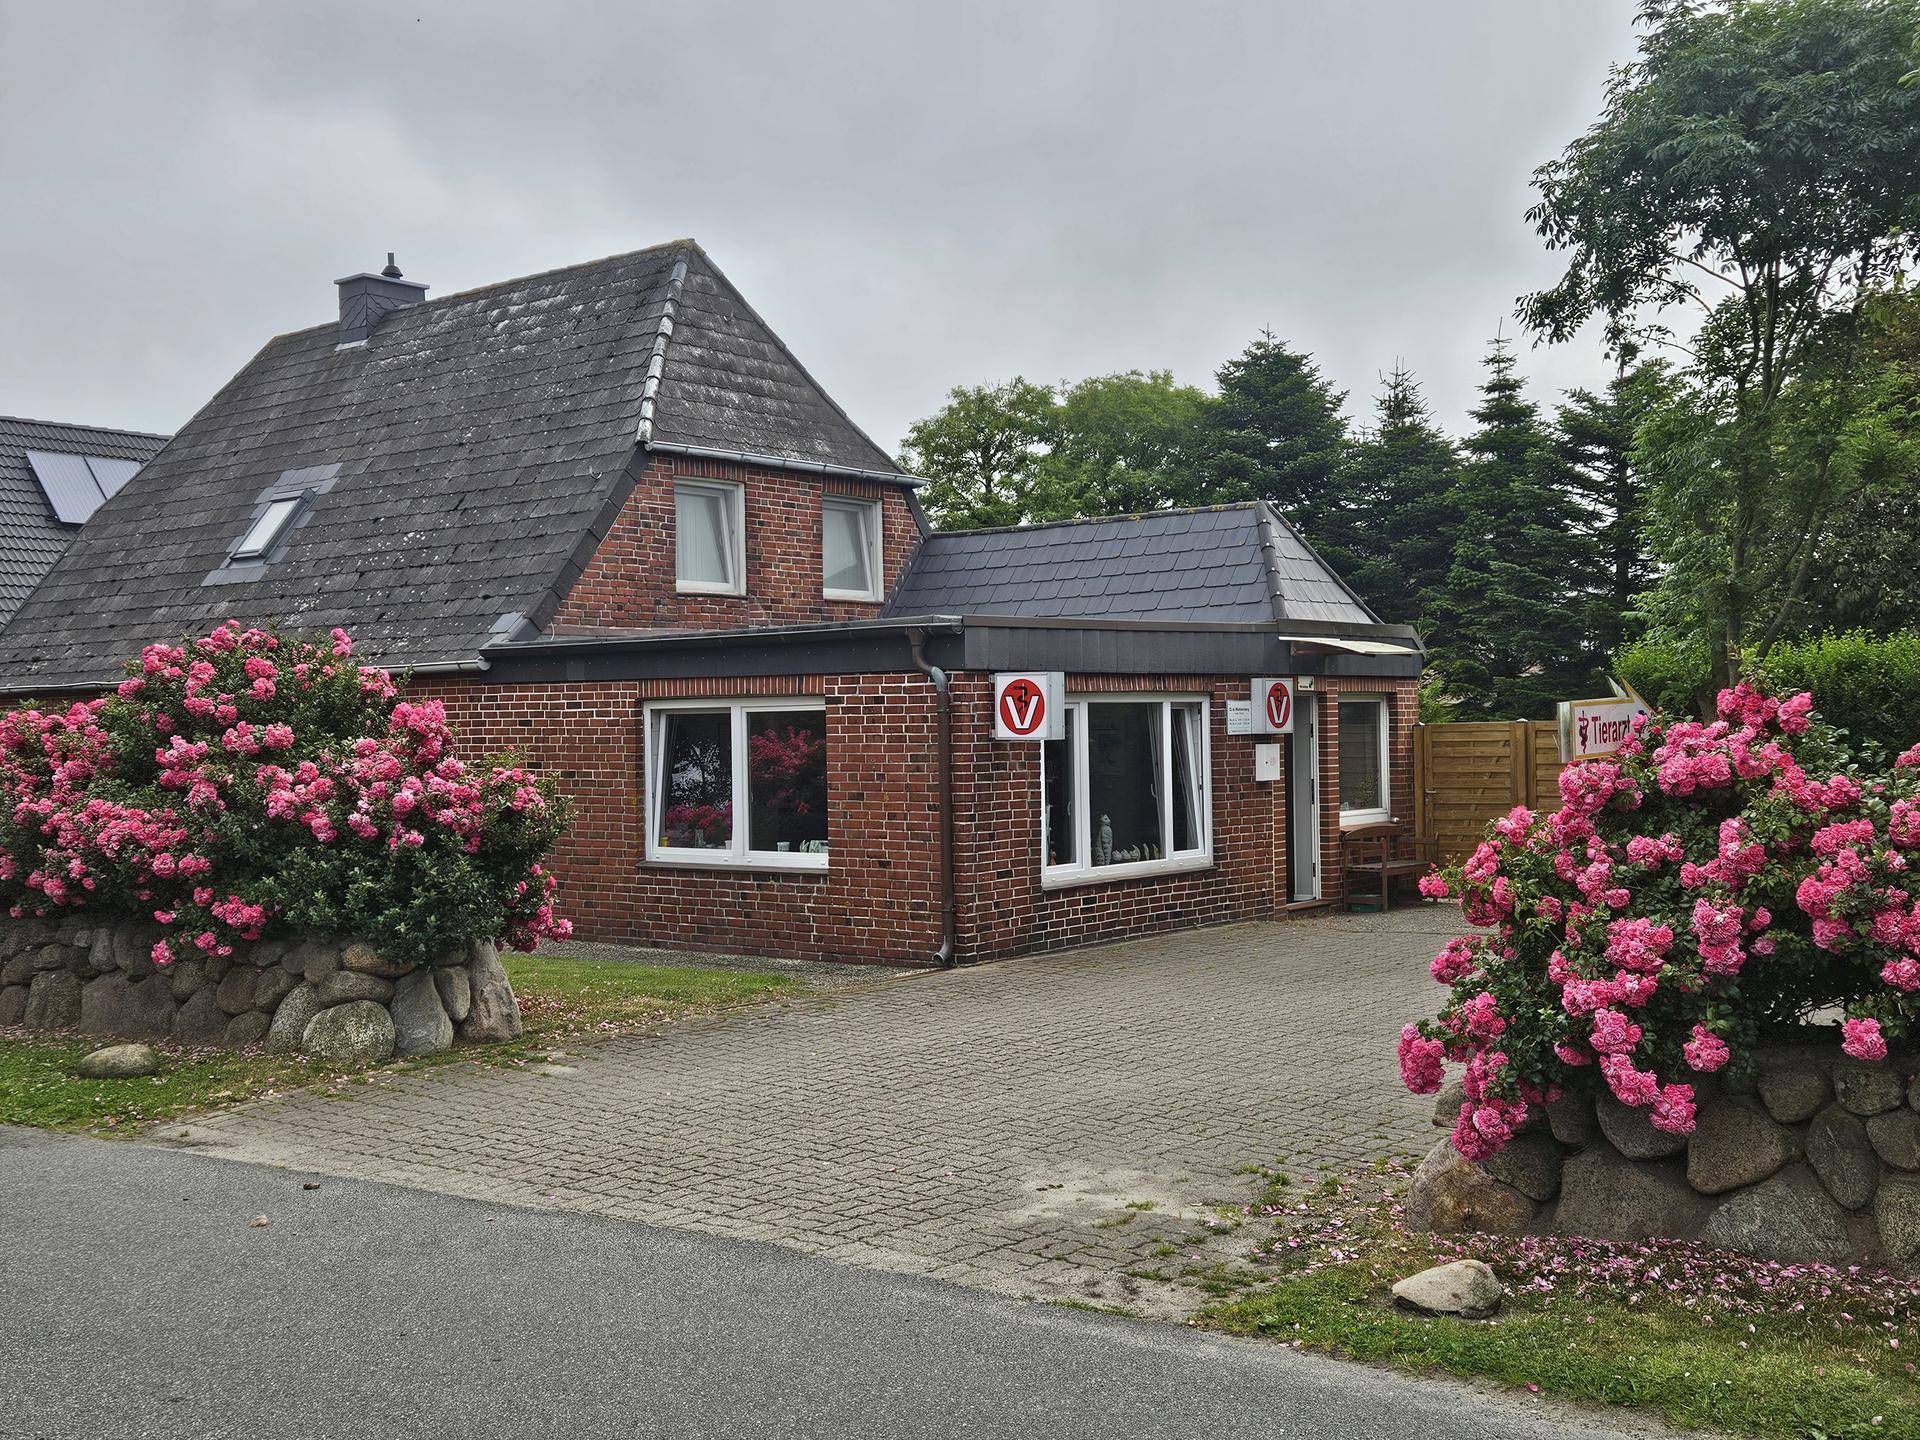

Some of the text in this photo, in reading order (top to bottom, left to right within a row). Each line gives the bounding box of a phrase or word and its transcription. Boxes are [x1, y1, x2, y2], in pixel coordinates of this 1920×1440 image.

[1004, 695, 1040, 730] V
[1269, 695, 1289, 724] V
[1591, 714, 1631, 745] Tierarzt
